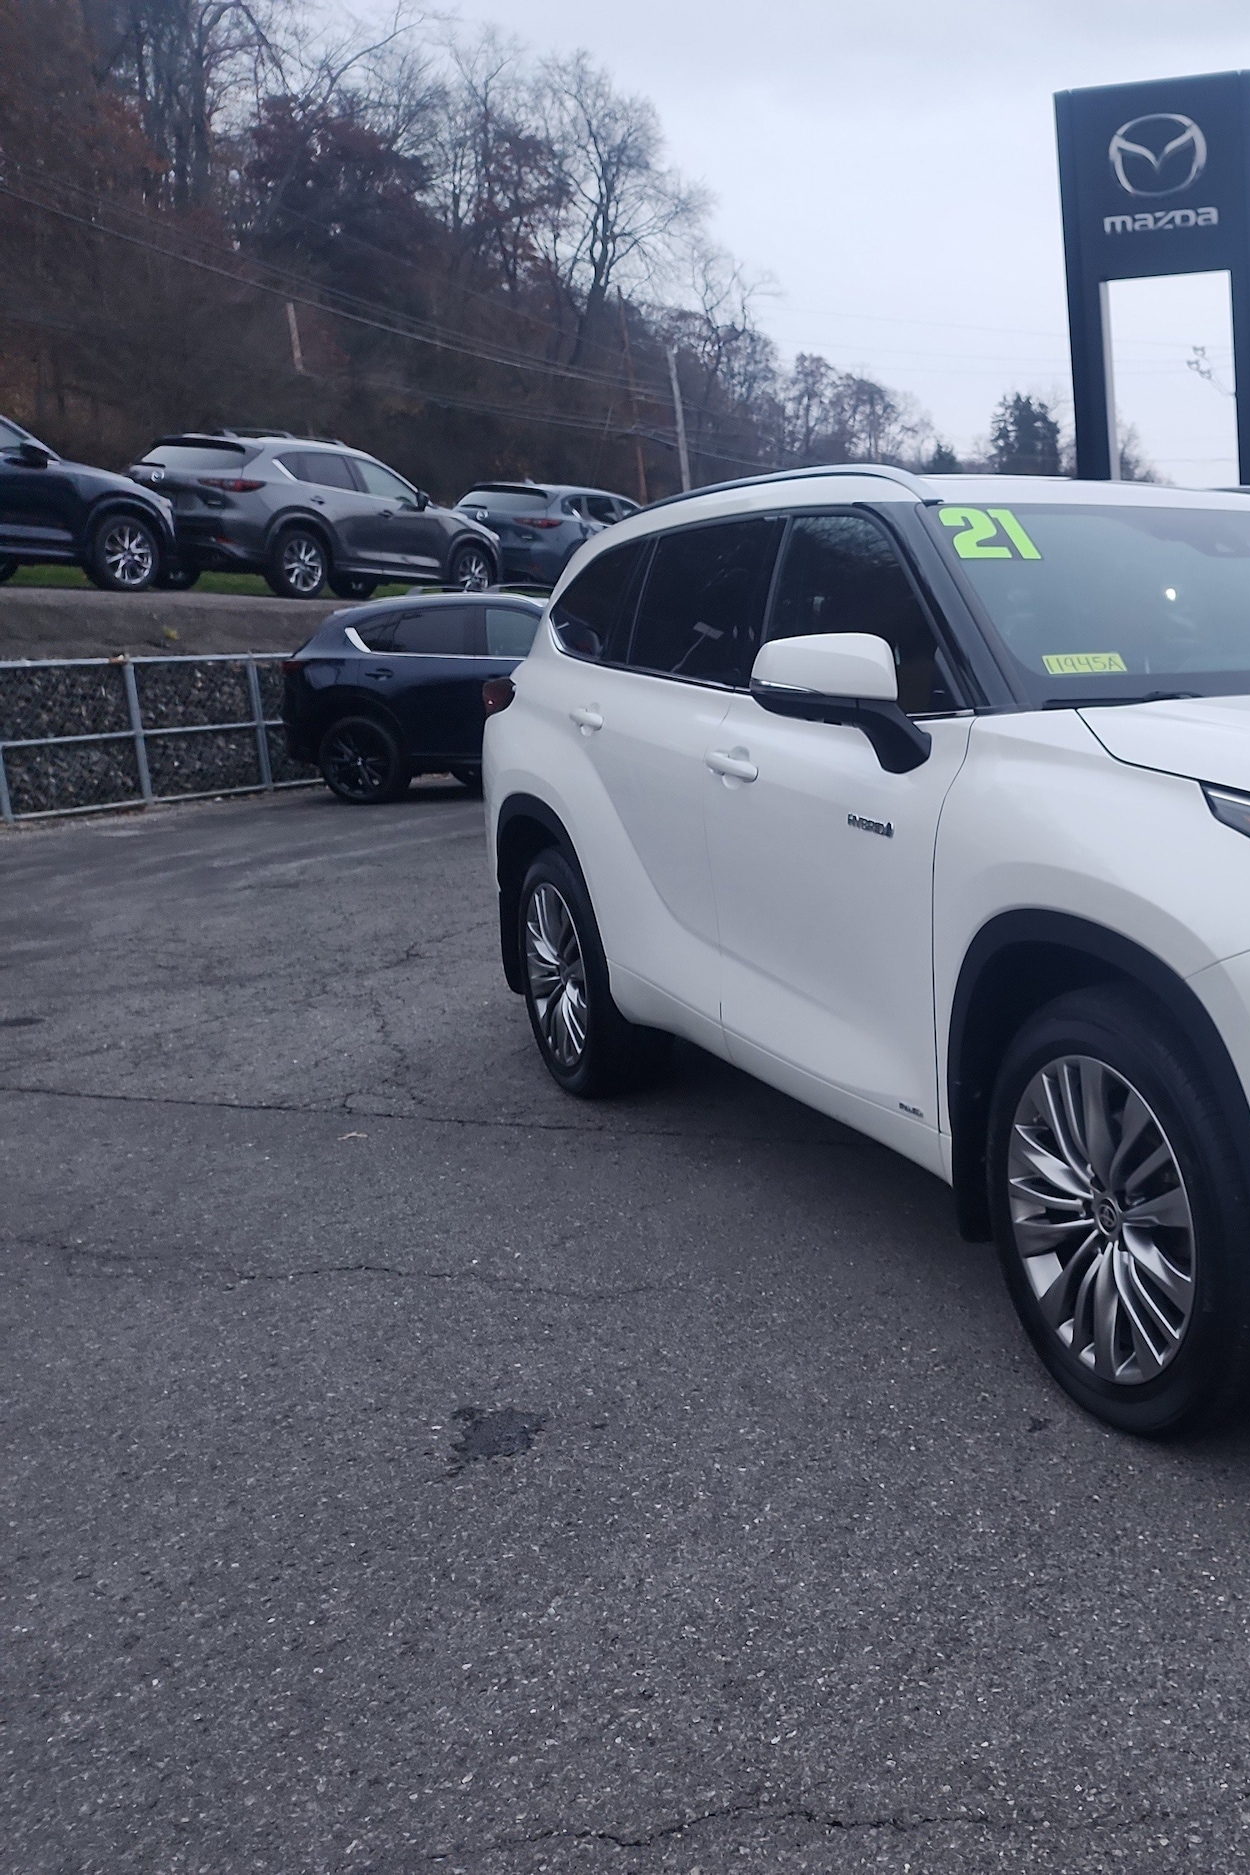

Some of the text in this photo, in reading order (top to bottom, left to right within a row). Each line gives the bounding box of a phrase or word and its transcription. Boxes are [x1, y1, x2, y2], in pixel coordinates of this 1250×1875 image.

[1103, 206, 1219, 235] mazda
[938, 507, 1042, 560] 21
[1045, 656, 1126, 673] 11945A
